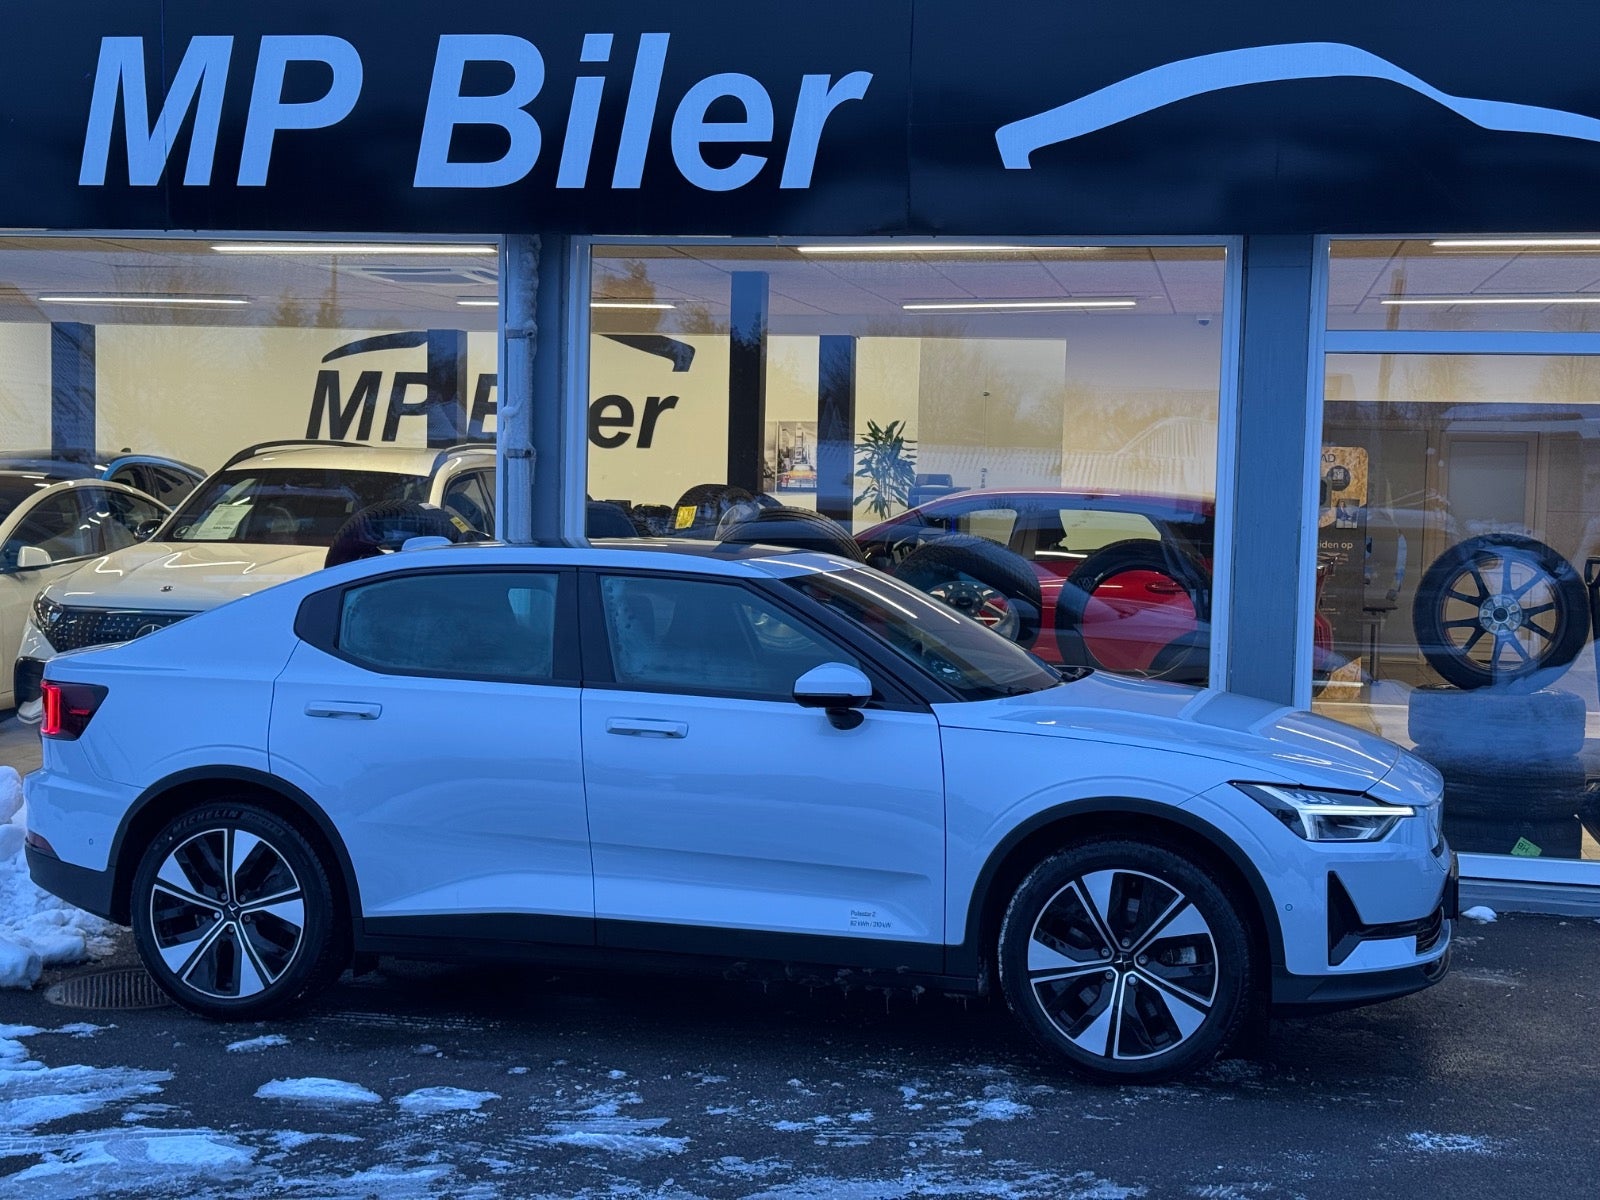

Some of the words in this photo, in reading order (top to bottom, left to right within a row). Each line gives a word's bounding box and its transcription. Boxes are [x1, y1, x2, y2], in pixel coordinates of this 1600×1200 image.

[78, 35, 364, 187] MP
[413, 33, 874, 191] Biler
[305, 370, 428, 442] MP
[1341, 542, 1353, 551] op
[172, 809, 239, 833] MICHELIN
